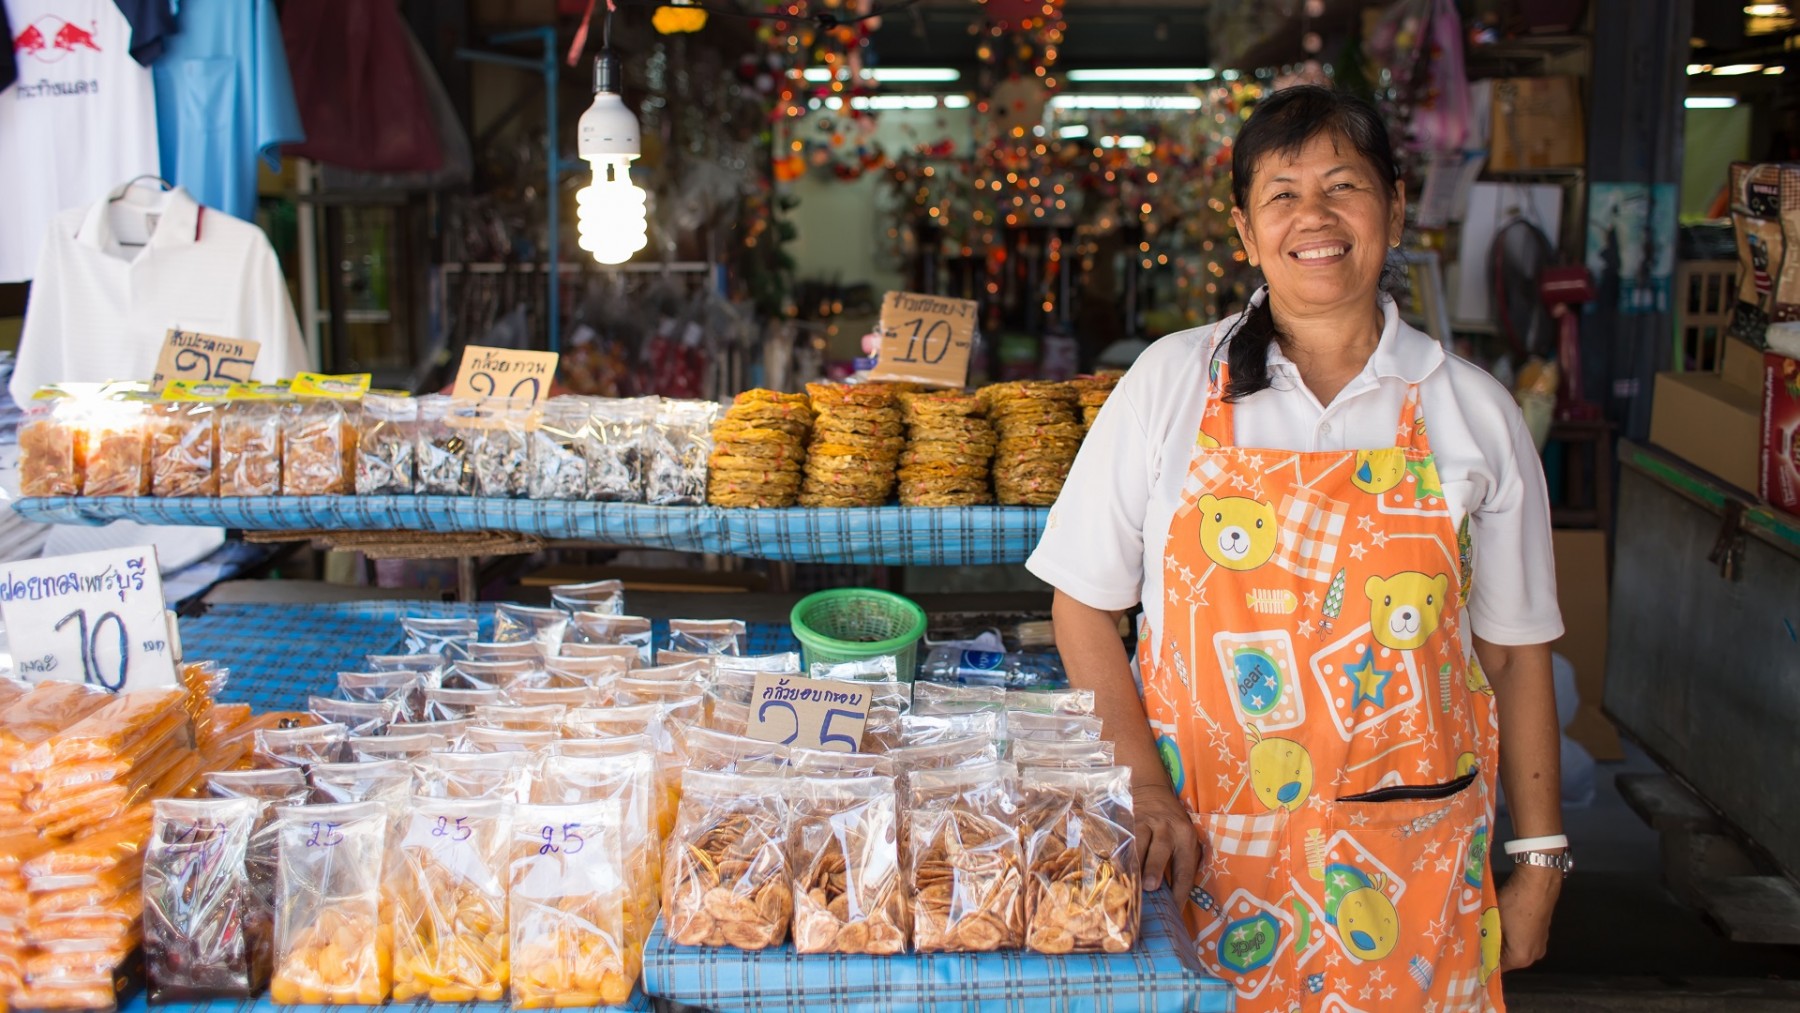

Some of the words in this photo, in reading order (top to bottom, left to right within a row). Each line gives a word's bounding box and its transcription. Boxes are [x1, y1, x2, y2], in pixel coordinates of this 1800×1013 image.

[892, 318, 952, 365] 10
[54, 608, 129, 693] 10
[757, 699, 866, 756] 25
[305, 821, 345, 847] 25
[431, 815, 472, 842] 25
[539, 822, 585, 855] 25
